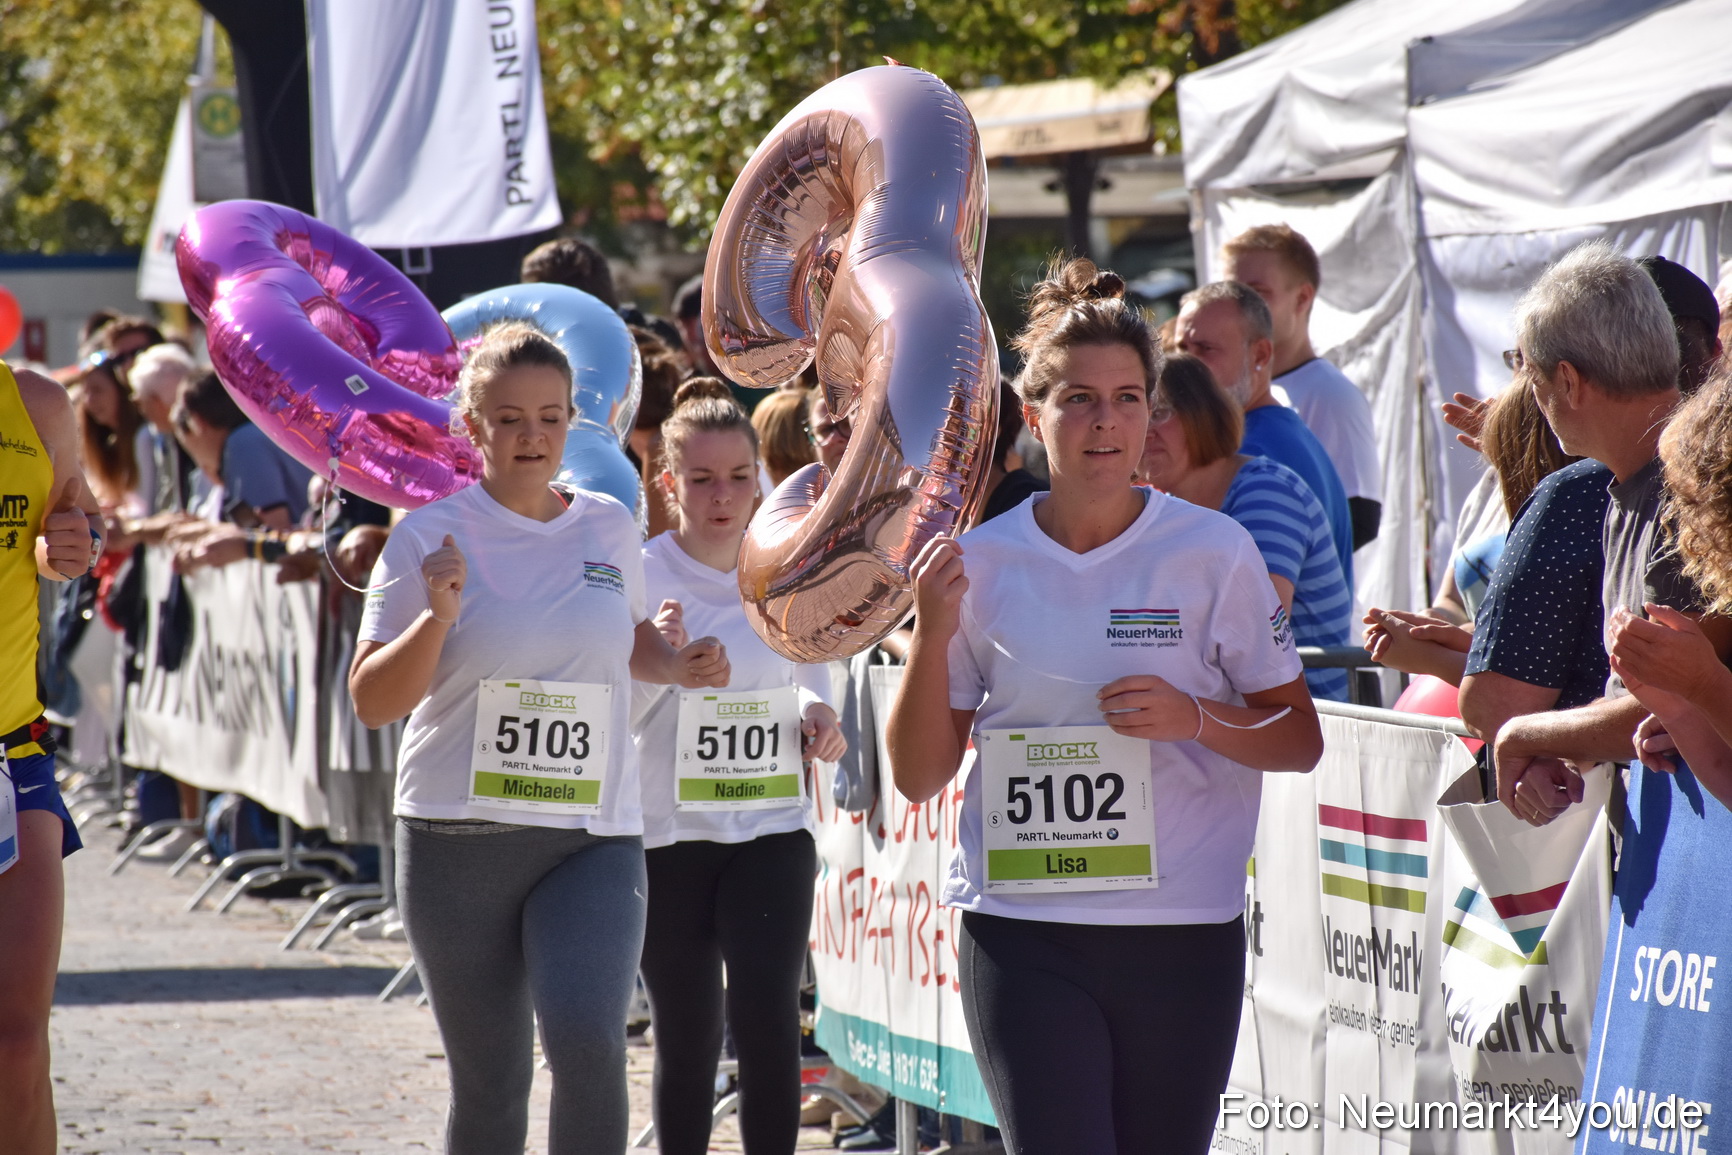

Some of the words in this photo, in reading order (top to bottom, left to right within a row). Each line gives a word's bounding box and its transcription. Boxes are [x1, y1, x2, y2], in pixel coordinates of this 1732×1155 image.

[490, 0, 523, 80] NEU
[501, 87, 533, 207] PARTL
[1106, 628, 1184, 639] NeuerMarkt
[519, 691, 577, 710] BOCK
[717, 700, 770, 715] BOCK
[495, 715, 590, 760] 5103
[696, 722, 779, 760] 5101
[1026, 742, 1100, 761] BOCK
[502, 760, 531, 771] PARTL
[532, 763, 571, 774] Neumarkt
[704, 766, 731, 774] PARTL
[732, 765, 768, 774] Neumarkt
[503, 778, 576, 800] Michaela
[715, 782, 765, 798] Nadine
[1006, 772, 1127, 825] 5102
[992, 815, 999, 825] S
[1016, 832, 1051, 842] PARTL
[1052, 830, 1103, 841] Neumarkt
[1046, 853, 1088, 874] Lisa
[1321, 913, 1423, 995] NeuerMark
[1630, 945, 1717, 1013] STORE
[1329, 998, 1368, 1032] einkaufen
[1609, 1085, 1712, 1155] ONLINE
